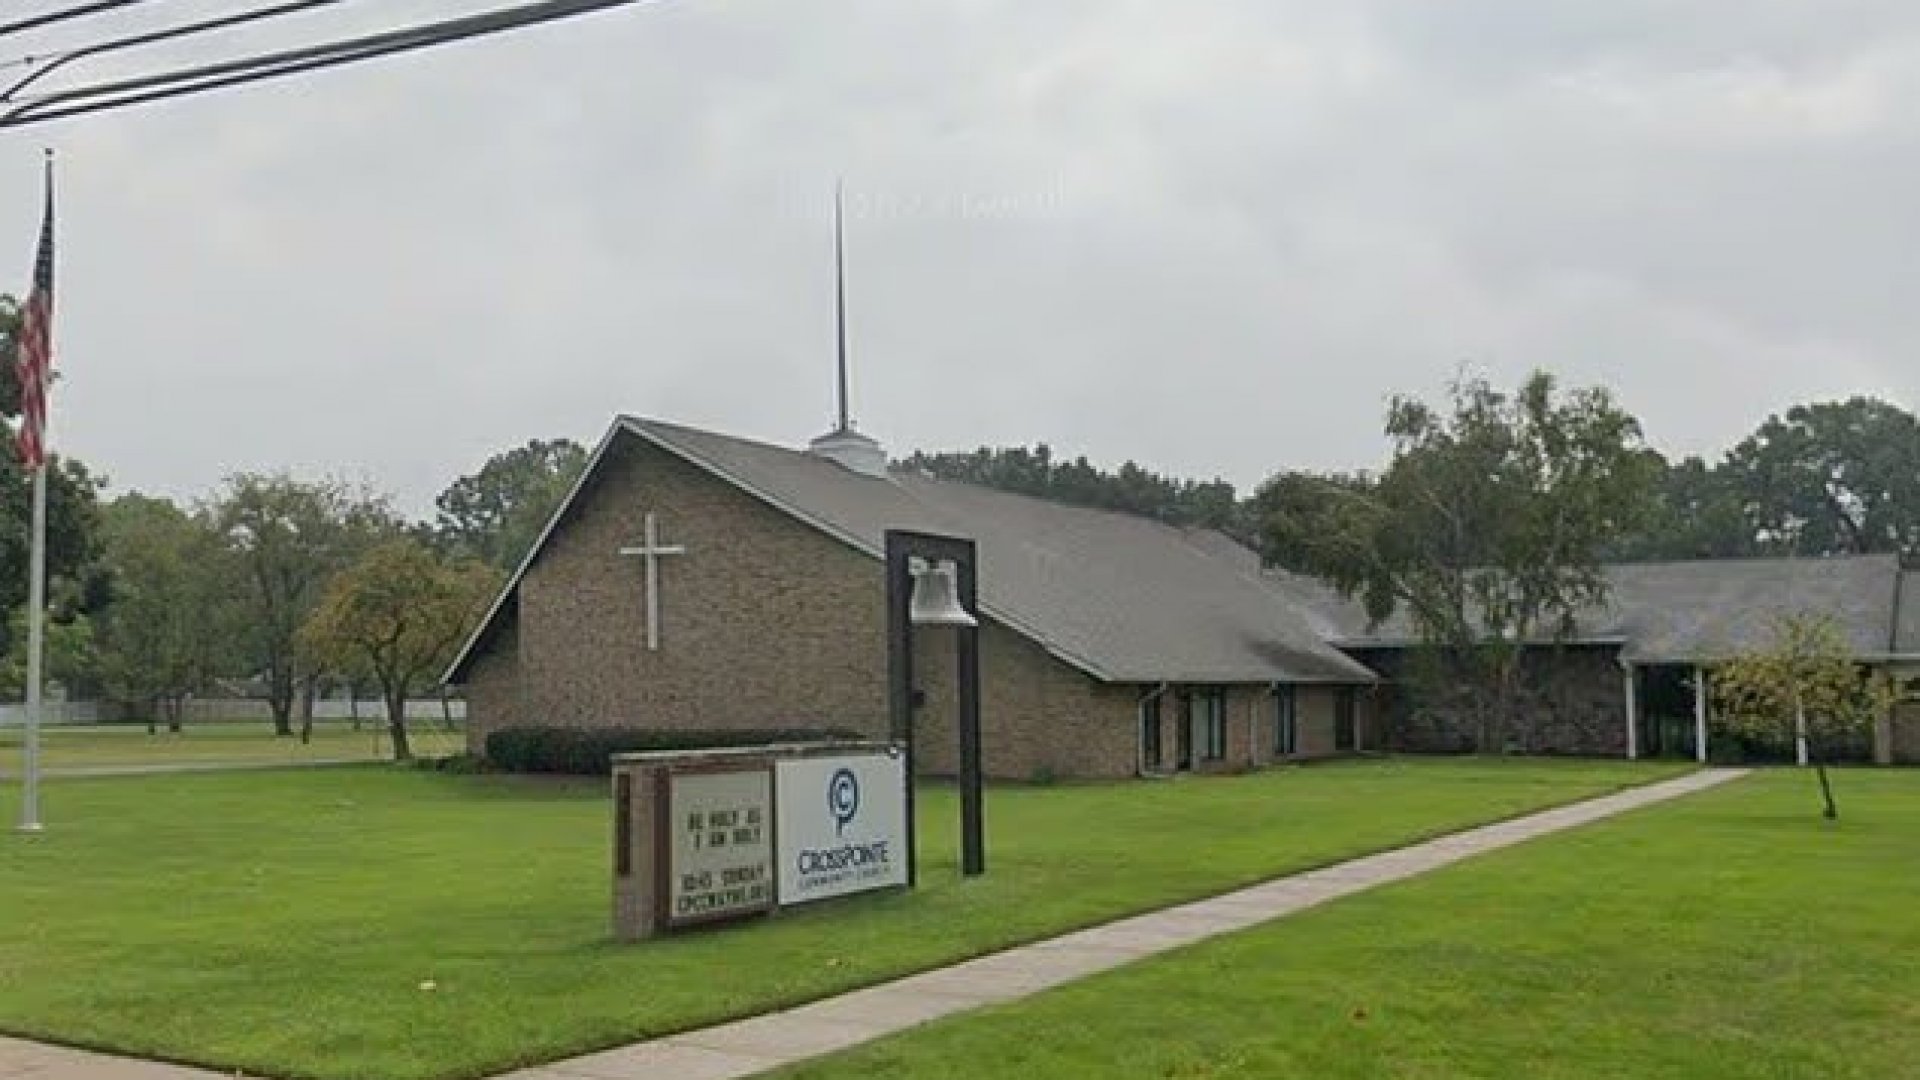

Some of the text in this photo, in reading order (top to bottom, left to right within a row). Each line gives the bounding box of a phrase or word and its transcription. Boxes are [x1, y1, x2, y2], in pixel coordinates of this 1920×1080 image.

[708, 810, 737, 827] HOLY
[694, 828, 761, 851] I AM HOLY
[720, 864, 764, 887] SUNDAY
